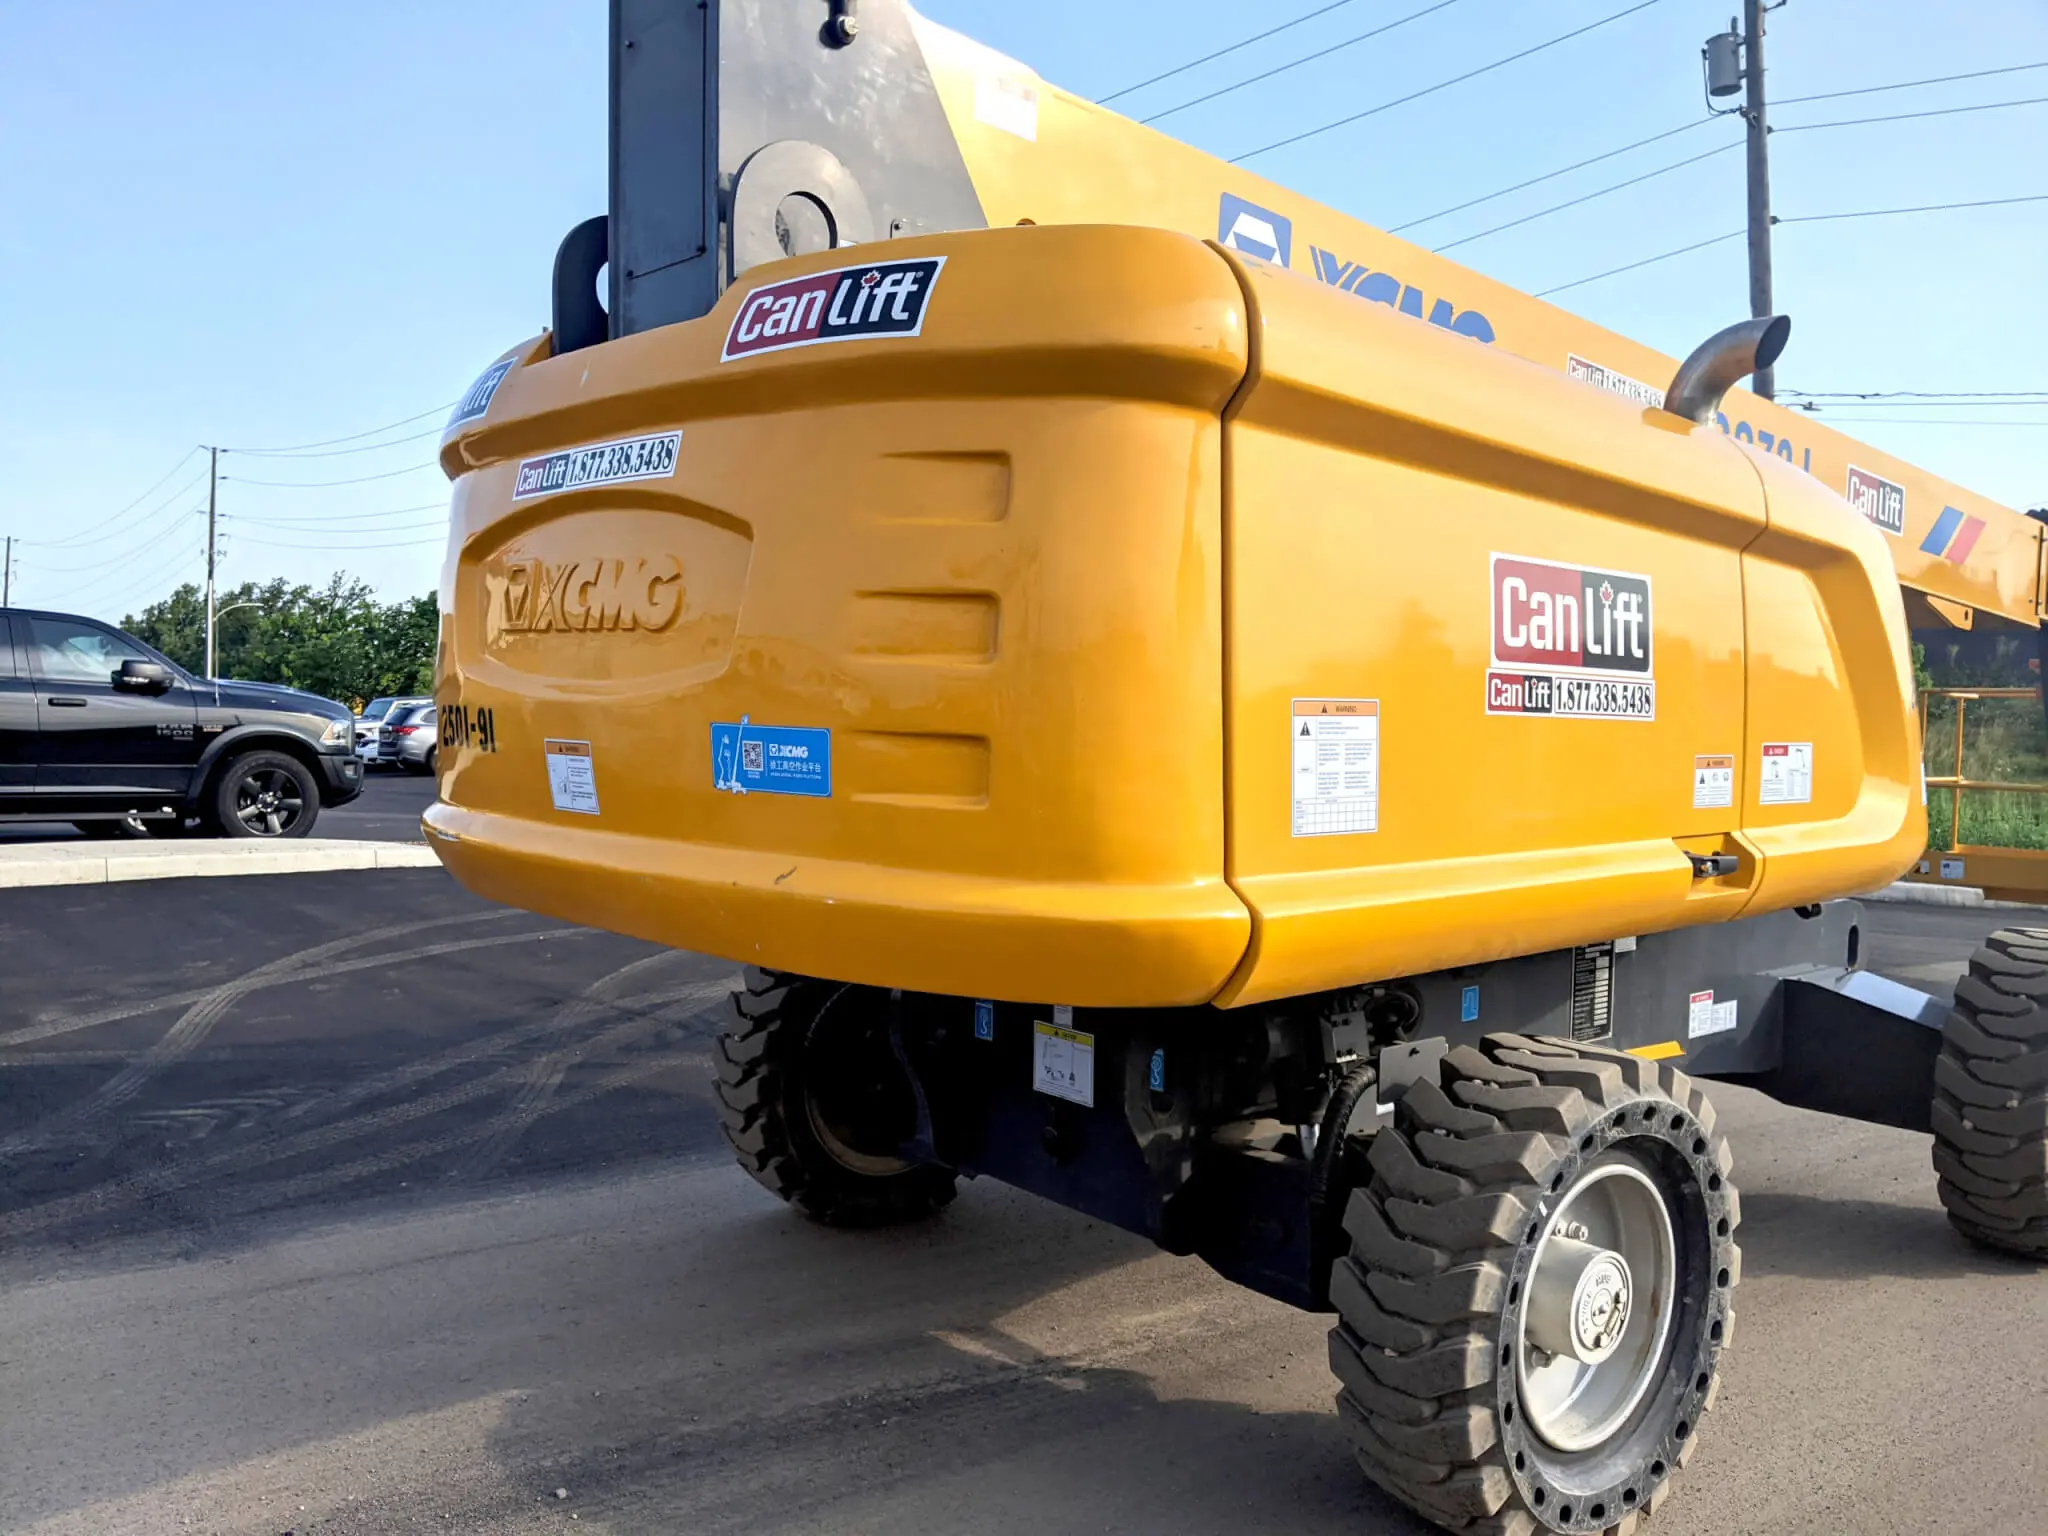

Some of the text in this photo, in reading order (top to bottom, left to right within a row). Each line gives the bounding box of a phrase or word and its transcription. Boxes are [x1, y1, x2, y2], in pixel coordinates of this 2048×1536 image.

[737, 271, 919, 344] CanLift
[518, 439, 675, 492] CanLift 1.877.338.5438
[1850, 475, 1901, 527] CanLift
[1502, 577, 1644, 659] CanLift
[1490, 678, 1651, 714] CanLift 1.877.338.5438
